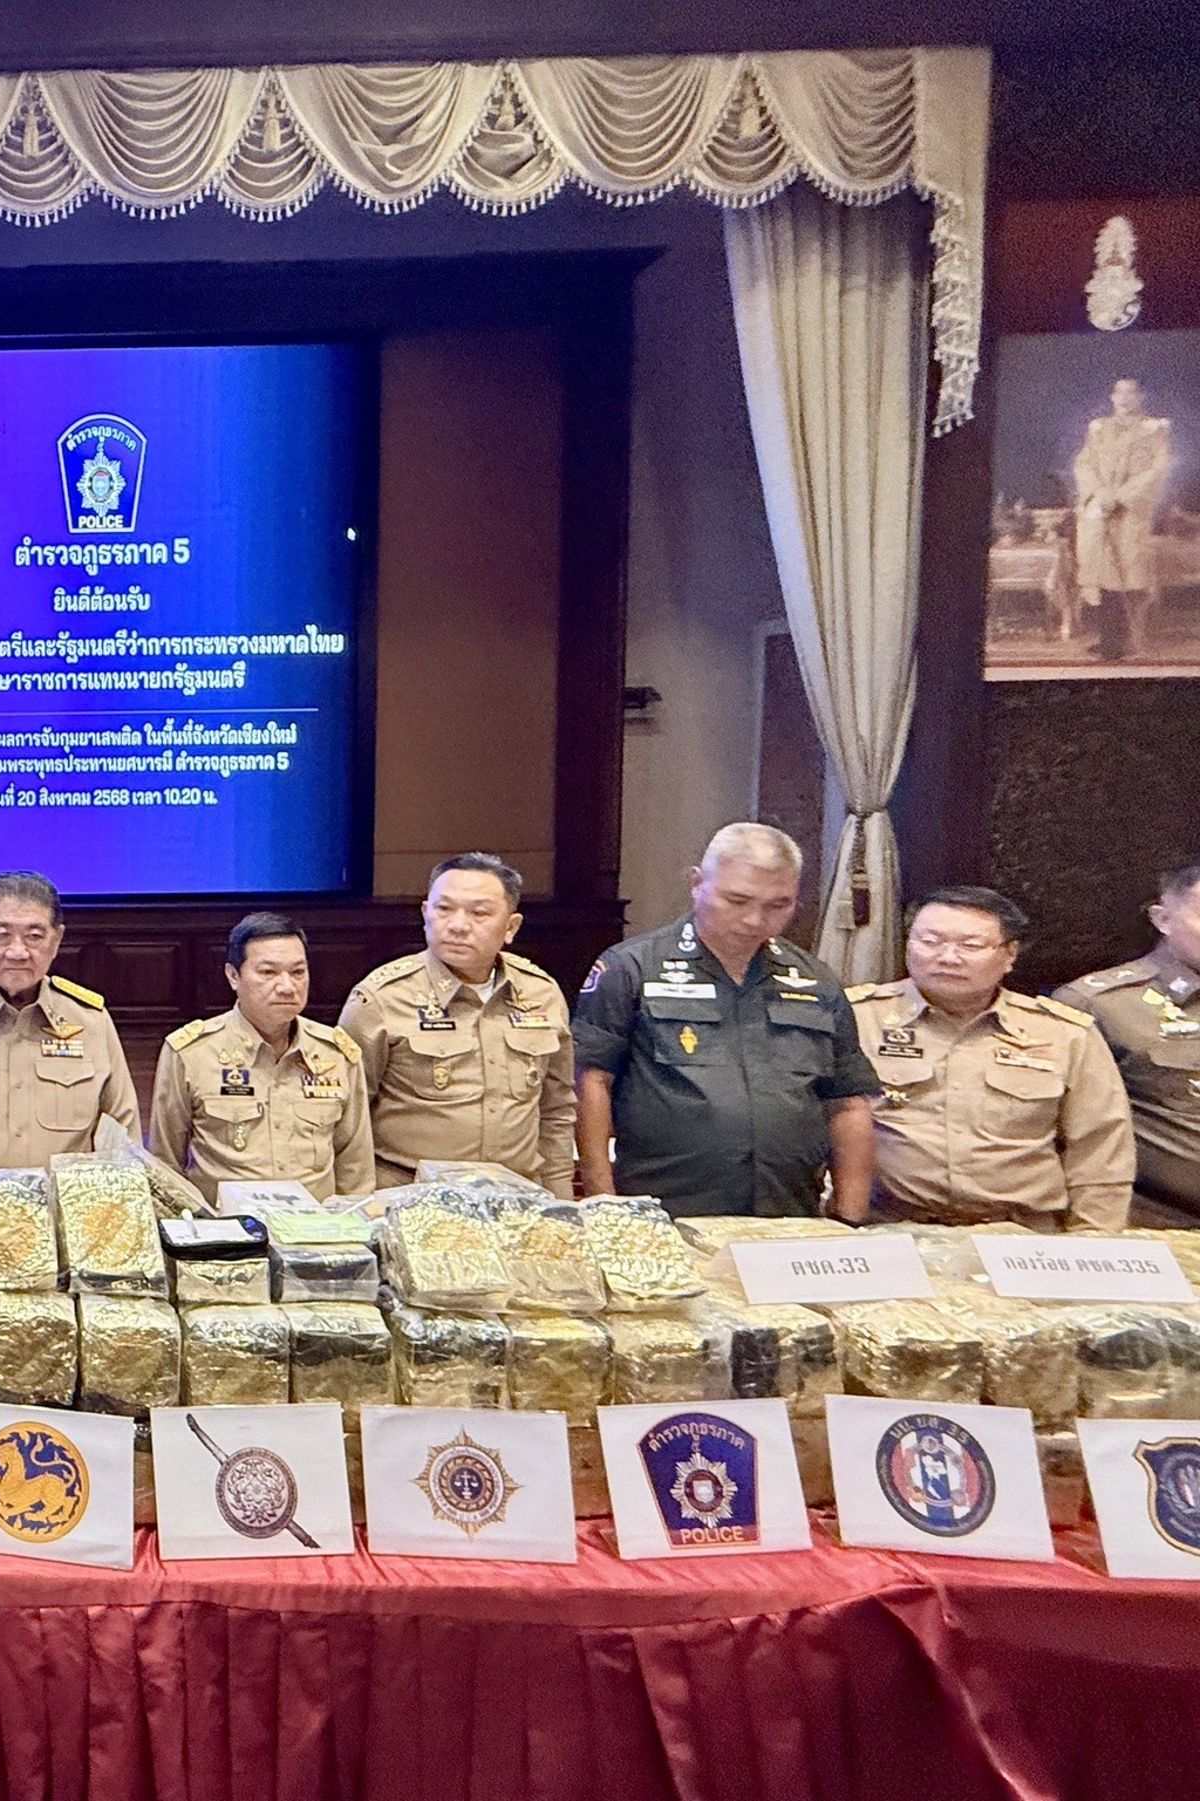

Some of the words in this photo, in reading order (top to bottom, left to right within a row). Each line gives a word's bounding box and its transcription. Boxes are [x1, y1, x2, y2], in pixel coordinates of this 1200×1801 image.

[78, 515, 124, 528] POLICE
[15, 536, 168, 575] ตำรวจภูธรภาค
[173, 538, 190, 564] 5
[54, 586, 151, 612] ยินดีต้อนรับ
[144, 717, 297, 745] ในพื้นที่จังหวัดเชียงใหม่
[175, 750, 275, 778] ตำรวจภูธรภาค
[276, 752, 289, 770] 5
[17, 790, 35, 806] 20
[39, 787, 91, 806] สิงหาคม
[93, 788, 130, 806] 2568
[132, 790, 162, 805] เวลา
[164, 788, 200, 804] 10.20
[203, 790, 218, 805] น.
[791, 1257, 871, 1275] ตชด.33
[1002, 1250, 1070, 1272] กองร้อย
[1075, 1257, 1161, 1275] ตชด.335
[649, 1421, 746, 1452] ตำรวจภูธรภาค
[681, 1525, 744, 1545] POLICE
